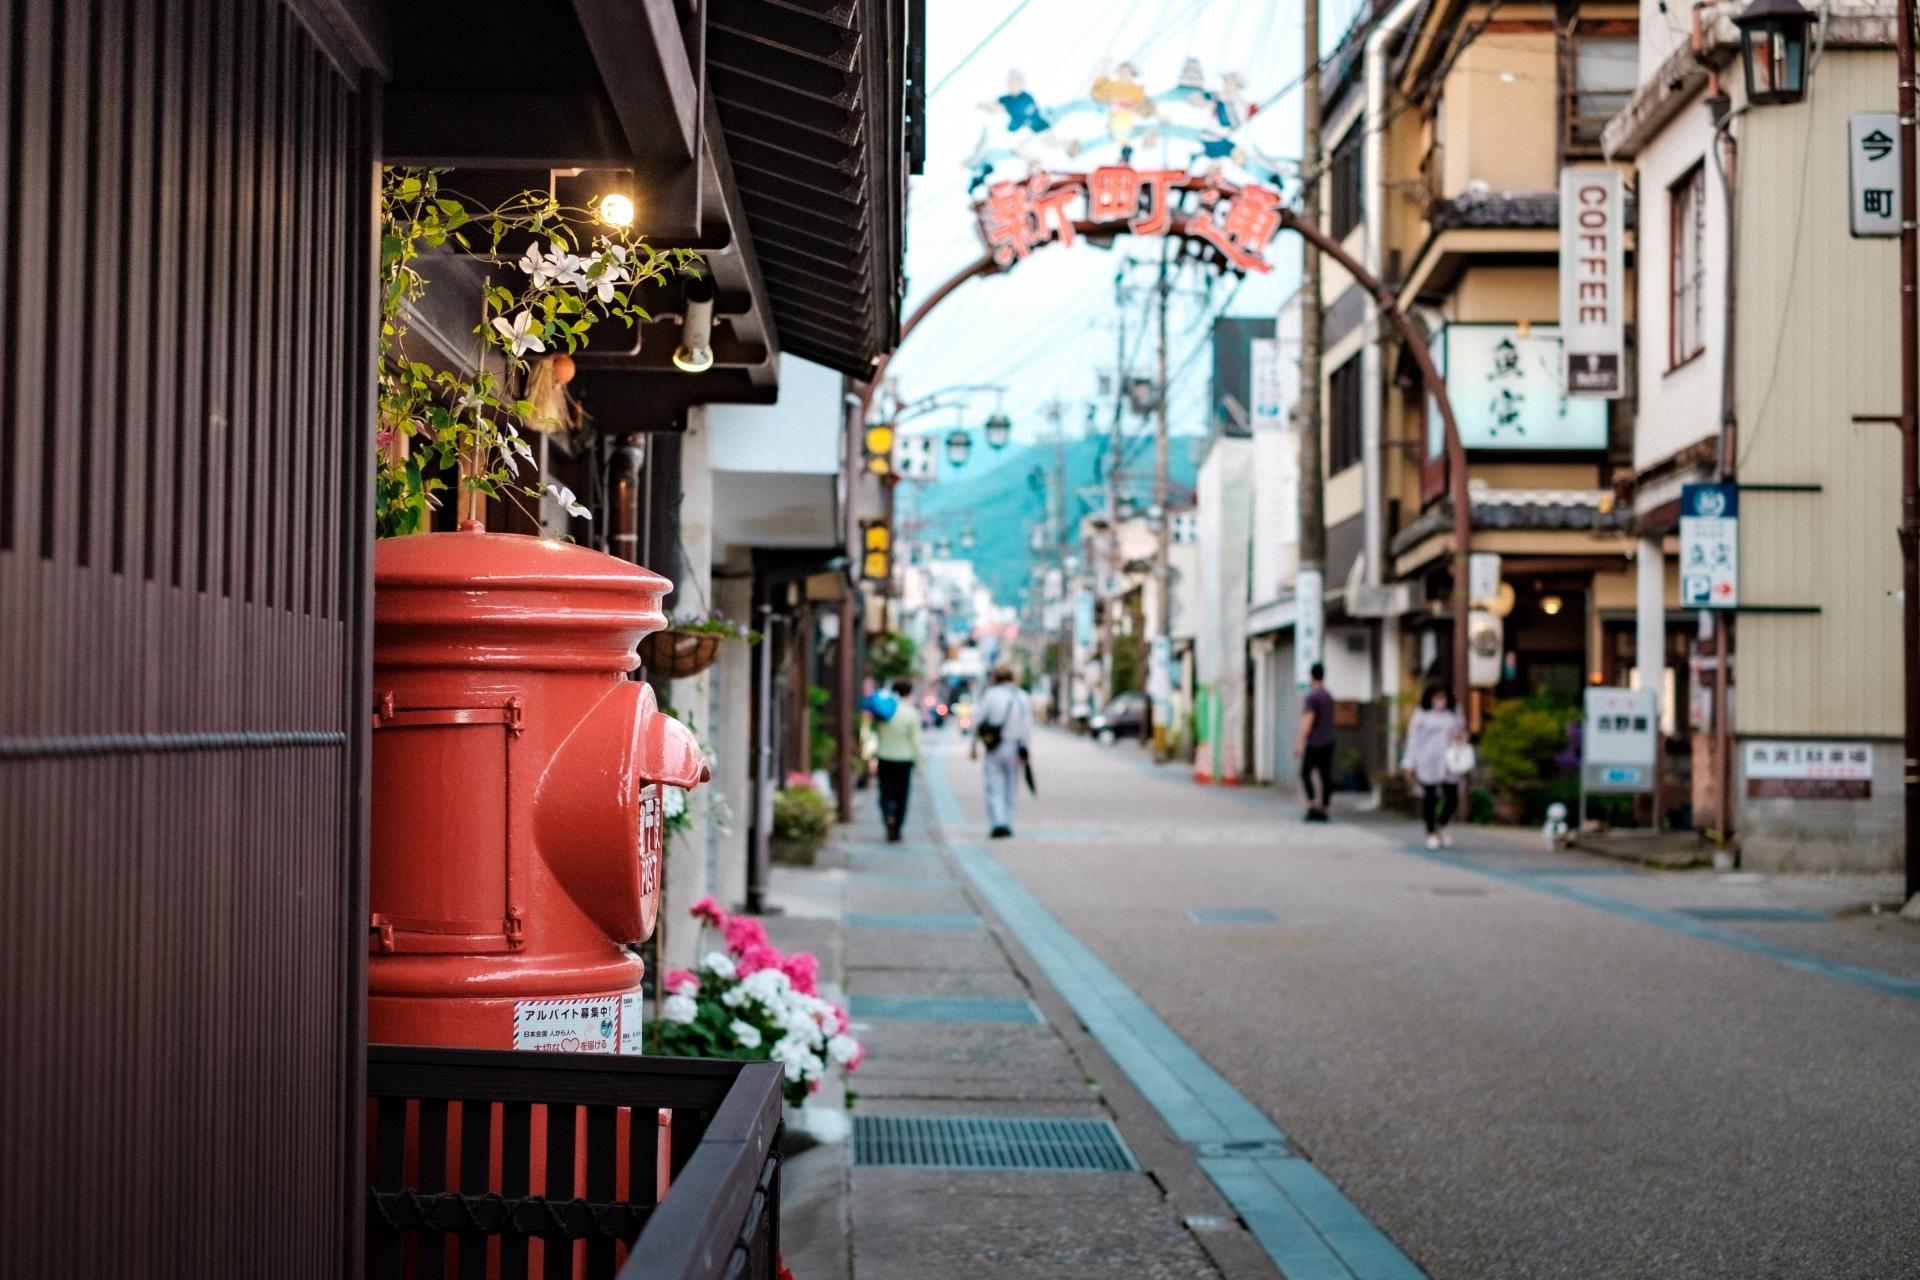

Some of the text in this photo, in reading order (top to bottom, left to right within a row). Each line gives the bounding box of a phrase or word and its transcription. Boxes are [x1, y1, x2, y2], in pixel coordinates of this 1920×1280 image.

[980, 166, 1282, 276] 新町通
[1861, 128, 1894, 218] 今町
[1578, 184, 1608, 327] COFFEE
[525, 1006, 612, 1021] アルバイト募集中!
